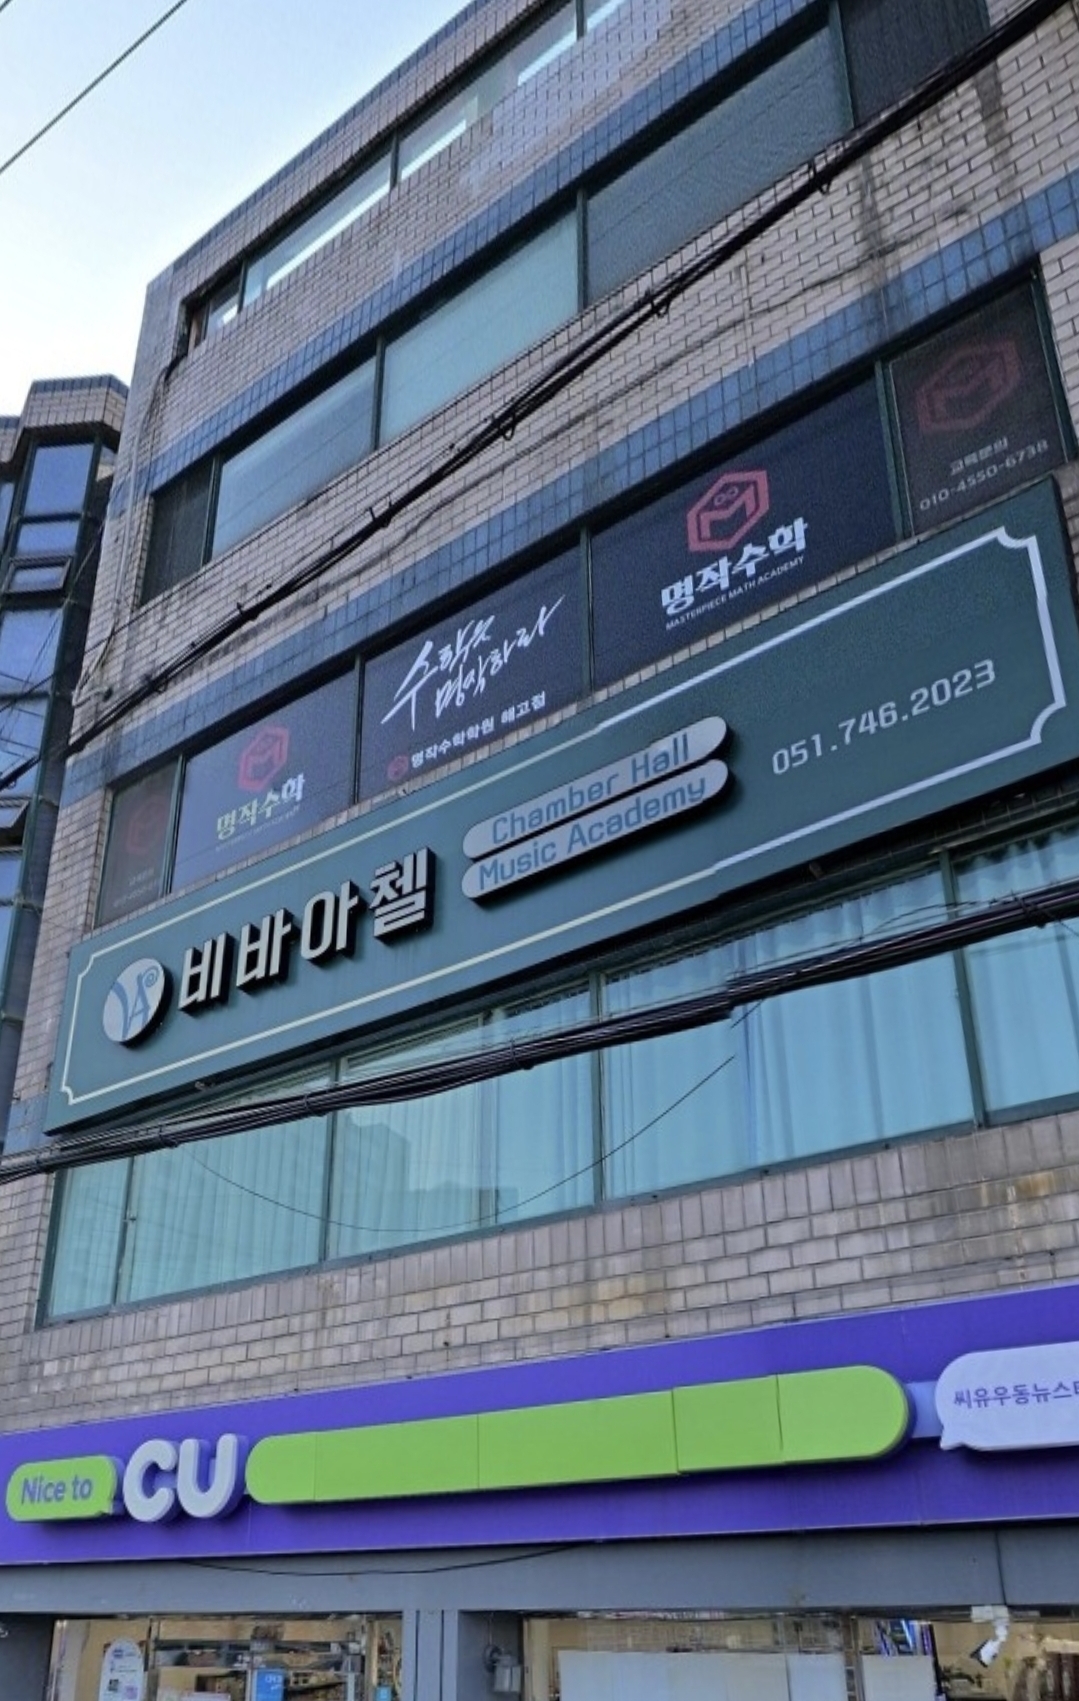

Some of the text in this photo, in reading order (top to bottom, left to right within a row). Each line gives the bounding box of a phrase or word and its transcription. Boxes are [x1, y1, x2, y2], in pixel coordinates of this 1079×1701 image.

[661, 517, 808, 616] 명작수학
[665, 555, 805, 631] MASTERPIECE MATH ACADEMY
[410, 716, 496, 768] 명작수학학원
[771, 658, 997, 775] 051.746.2023
[215, 772, 305, 841] 명작수학
[478, 778, 706, 891] Music Academy
[491, 733, 689, 845] Chamber Hall
[178, 846, 430, 1012] 비바아첼
[21, 1433, 239, 1522] Nice to CU
